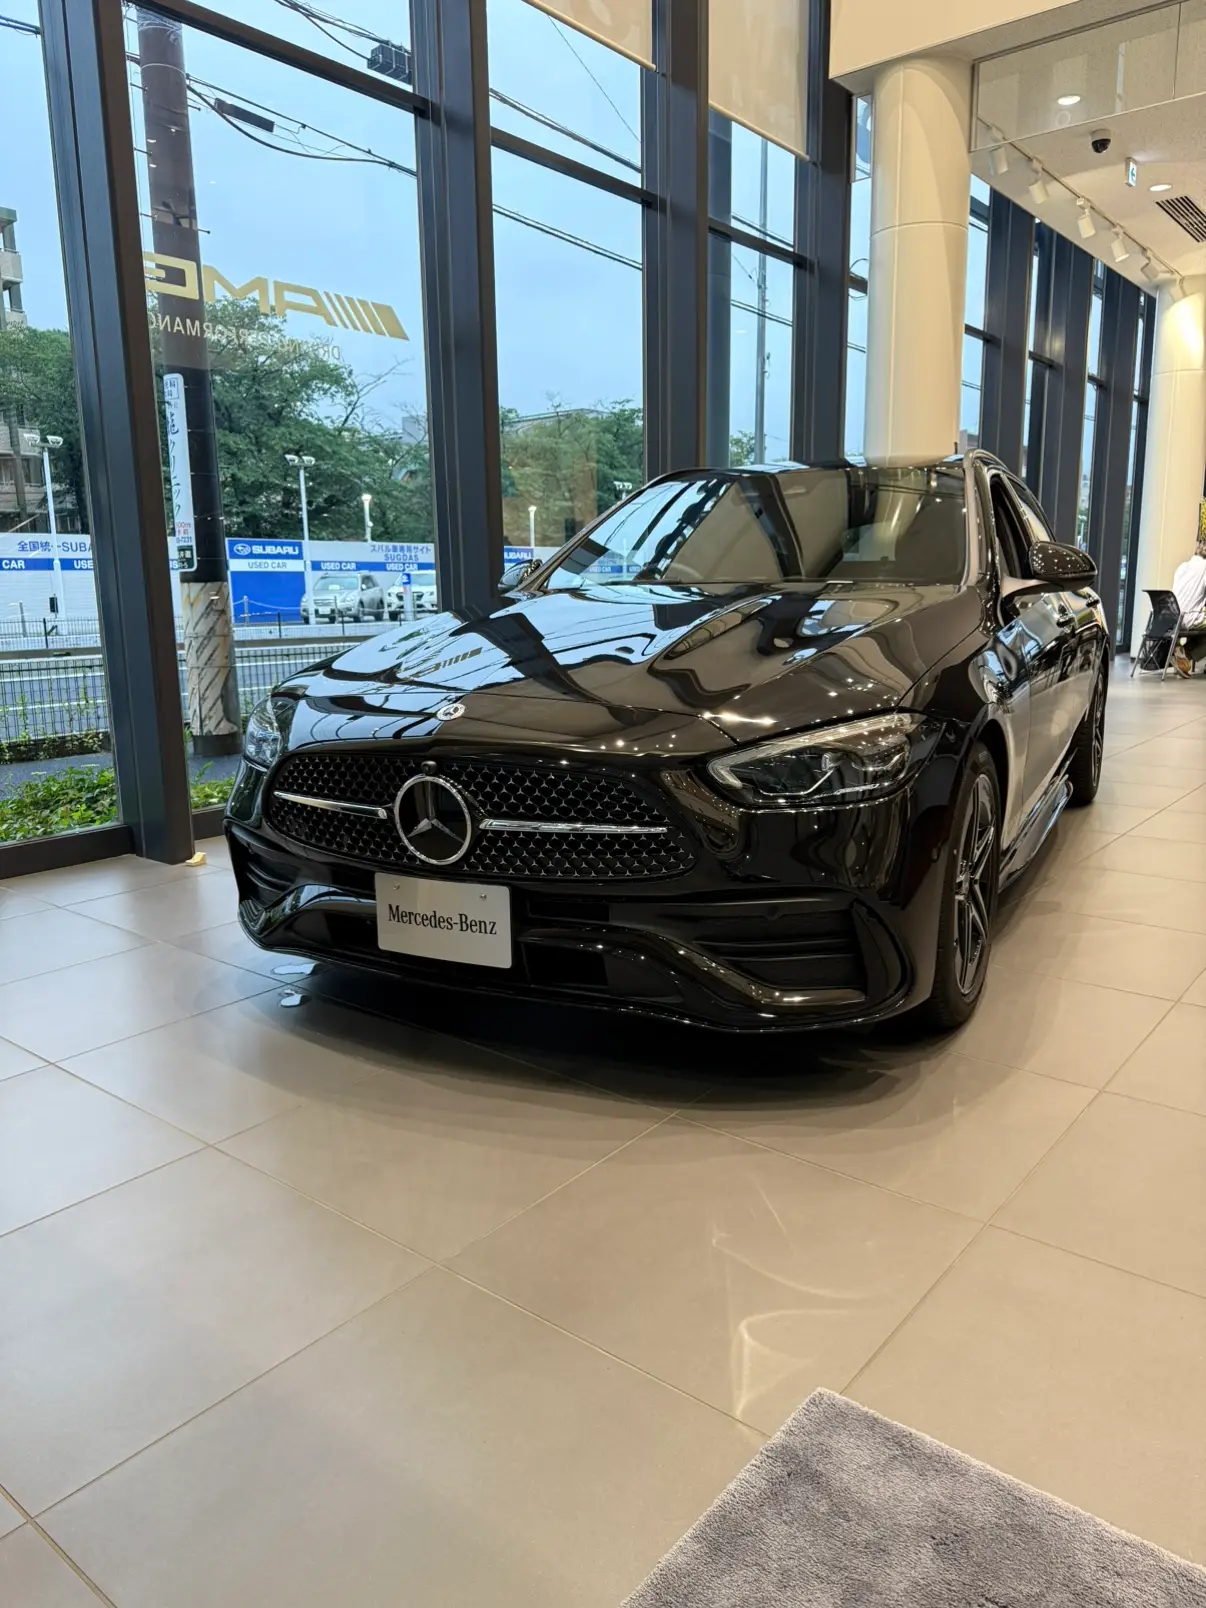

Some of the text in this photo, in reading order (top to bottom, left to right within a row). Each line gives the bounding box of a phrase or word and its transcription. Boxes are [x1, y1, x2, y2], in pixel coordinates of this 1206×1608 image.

[252, 545, 299, 555] SUBARU
[2, 560, 25, 569] CAR
[321, 562, 357, 570] USED CAR
[386, 563, 404, 571] USED
[388, 903, 497, 935] Mercedes-Benz
